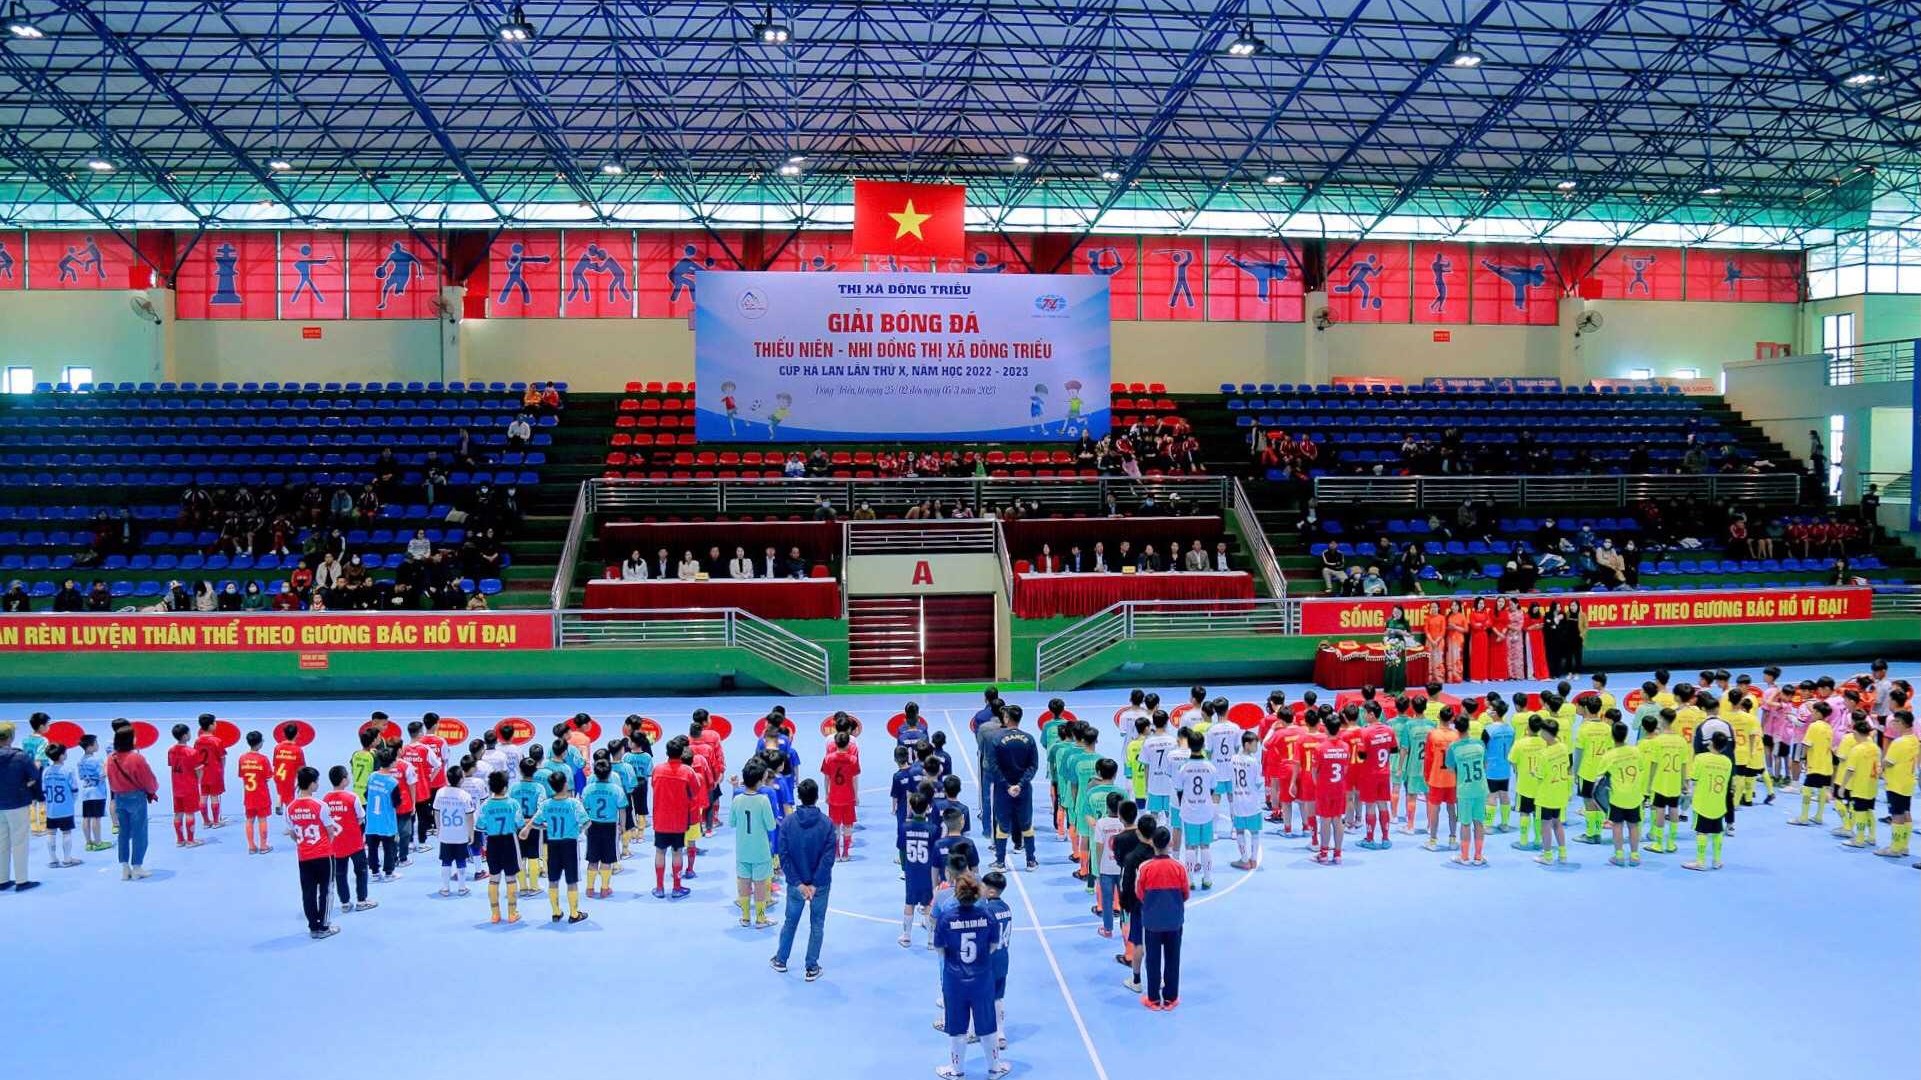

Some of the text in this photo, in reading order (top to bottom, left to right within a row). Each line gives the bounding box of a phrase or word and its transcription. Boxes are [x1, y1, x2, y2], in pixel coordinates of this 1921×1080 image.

[827, 308, 979, 333] GIẢI BÓNG ĐÁ
[753, 335, 794, 358] THIẾU
[799, 338, 833, 358] NIÊN
[848, 342, 872, 358] NHI
[921, 342, 942, 362] THỊ
[821, 366, 844, 376] LAN
[966, 366, 992, 376] 2022
[1003, 366, 1028, 376] 2023
[912, 561, 934, 585] A
[1588, 604, 1618, 626] HỌC
[1621, 601, 1650, 625] TẬP
[1653, 602, 1690, 620] THEO
[1694, 600, 1743, 619] GƯƠNG
[1746, 597, 1776, 617] BÁC
[1818, 598, 1849, 619] ĐẠI!
[24, 622, 65, 645] RÈN
[72, 622, 136, 648] LUYỆN
[142, 622, 195, 645] THÂN
[201, 618, 241, 645] THỂ
[244, 626, 295, 645] THEO
[301, 624, 370, 645] GƯƠNG
[376, 621, 418, 644] BÁC
[423, 618, 451, 644] HỒ
[456, 621, 477, 643] VĨ
[480, 624, 516, 648] ĐẠI
[1220, 737, 1229, 756] 6
[1155, 749, 1164, 768] 7
[1377, 748, 1389, 768] 9
[1662, 753, 1681, 773] 20
[275, 763, 287, 781] 4
[356, 764, 366, 783] 7
[834, 767, 845, 786] 6
[1232, 768, 1248, 788] 18
[1330, 763, 1342, 783] 3
[1462, 760, 1482, 783] 15
[1618, 765, 1637, 784] 19
[245, 773, 257, 792] 3
[1192, 776, 1203, 796] 8
[1708, 772, 1725, 794] 18
[373, 795, 380, 815] 1
[596, 797, 607, 819] 2
[441, 808, 464, 828] 66
[494, 817, 506, 834] 7
[550, 816, 565, 837] 11
[744, 809, 751, 834] 1
[905, 840, 928, 864] 55
[960, 932, 977, 964] 5
